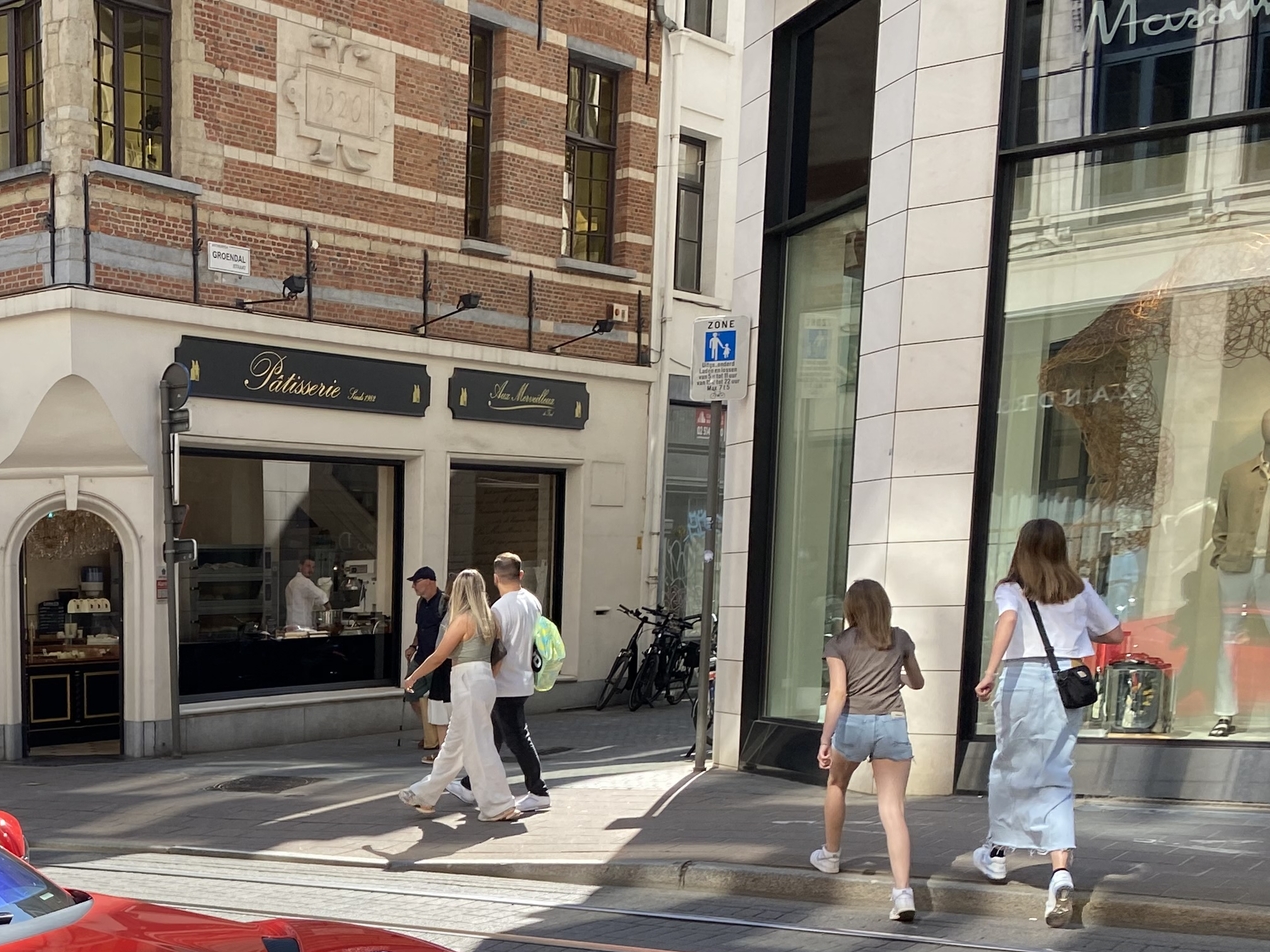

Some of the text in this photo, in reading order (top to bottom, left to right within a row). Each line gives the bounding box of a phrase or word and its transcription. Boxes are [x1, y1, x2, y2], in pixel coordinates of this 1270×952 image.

[316, 86, 362, 123] 1520
[212, 250, 246, 264] GROENDAL
[708, 320, 736, 329] ZONE
[244, 351, 340, 398] Pâtisserie
[490, 380, 555, 406] Aux Merveilleux
